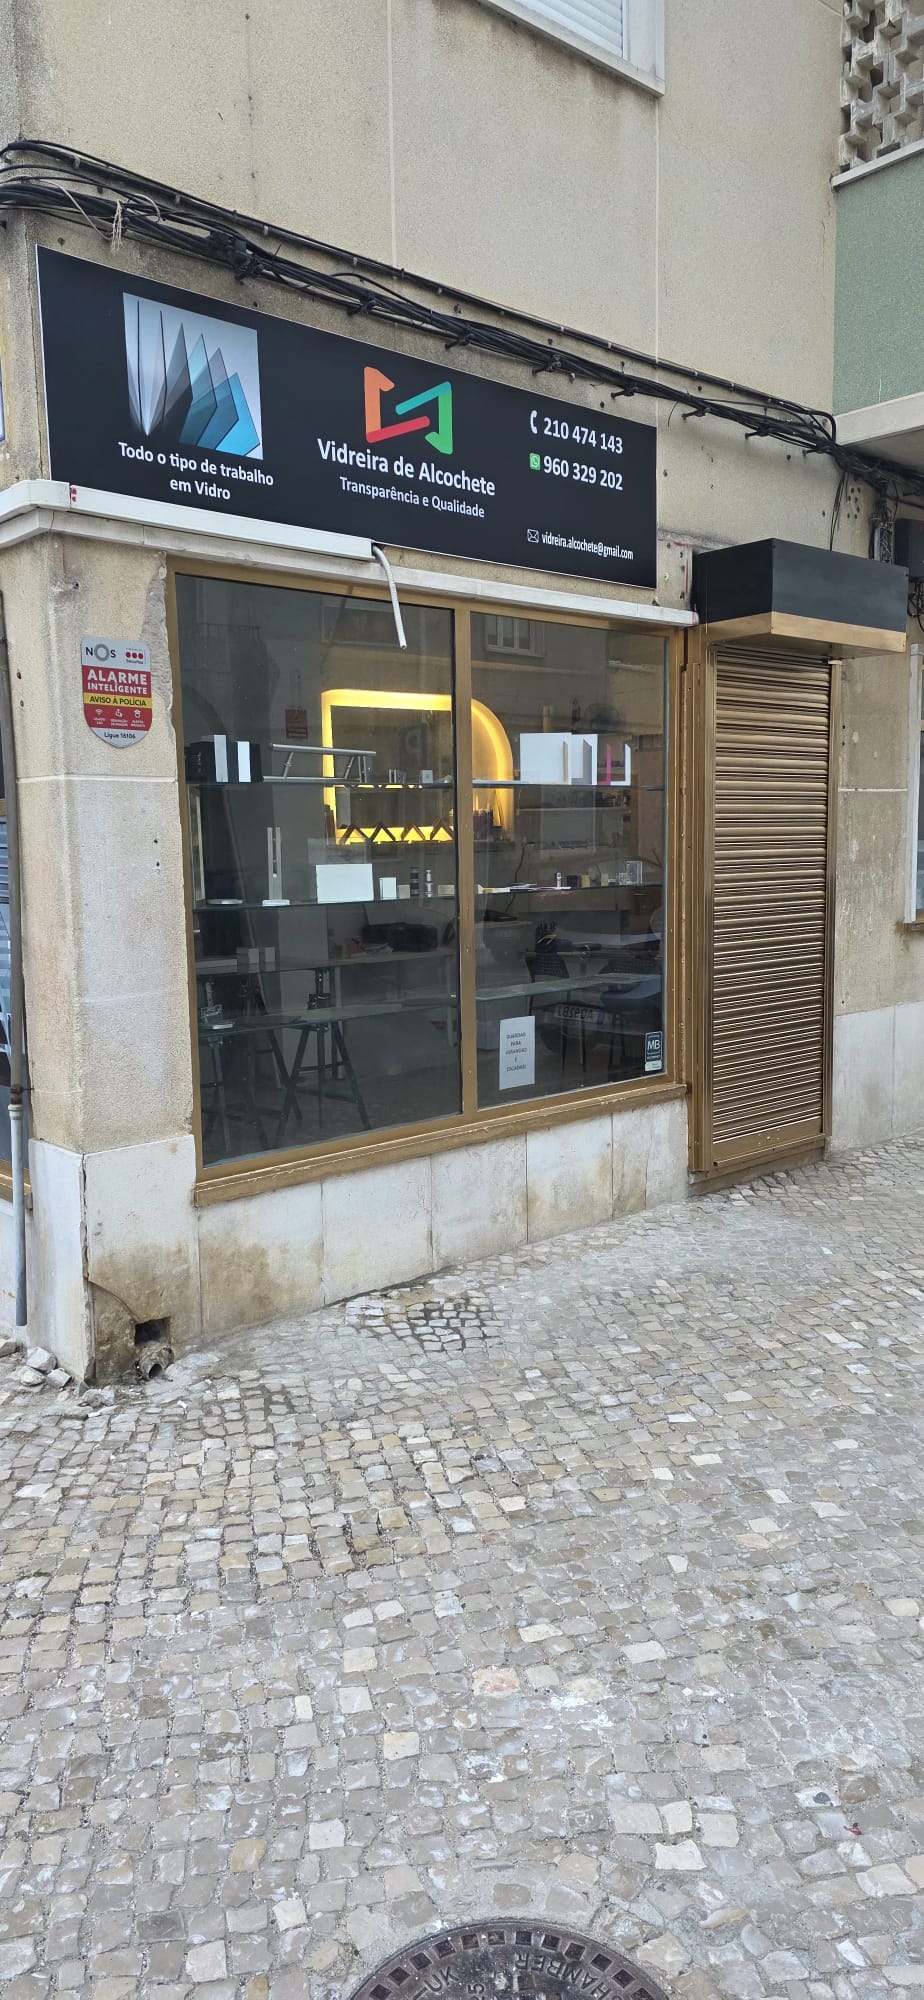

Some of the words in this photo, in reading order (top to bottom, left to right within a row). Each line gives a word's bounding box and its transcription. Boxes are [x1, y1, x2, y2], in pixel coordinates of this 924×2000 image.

[543, 417, 570, 440] 210
[571, 425, 597, 448] 474
[600, 432, 623, 454] 143
[117, 441, 154, 462] Todo
[157, 453, 167, 465] o
[169, 452, 198, 472] tipo
[200, 458, 218, 475] de
[219, 463, 274, 486] trabalho
[316, 438, 389, 473] Vidreira
[393, 455, 415, 479] de
[418, 462, 496, 496] Alcochete
[543, 455, 570, 478] 960
[572, 462, 597, 484] 329
[600, 469, 623, 491] 202
[169, 479, 192, 493] em
[194, 480, 231, 500] Vidro
[339, 476, 420, 505] Transparência
[422, 496, 429, 507] e
[431, 495, 485, 518] Qualidade
[541, 531, 634, 560] vidreira.alcochete@gmail.com
[85, 643, 116, 662] NOS
[87, 682, 148, 695] INTELIGENTE
[88, 669, 148, 685] ALARME
[90, 695, 112, 704] AVISO
[119, 698, 147, 707] POLÍCIA
[647, 1039, 661, 1051] MB
